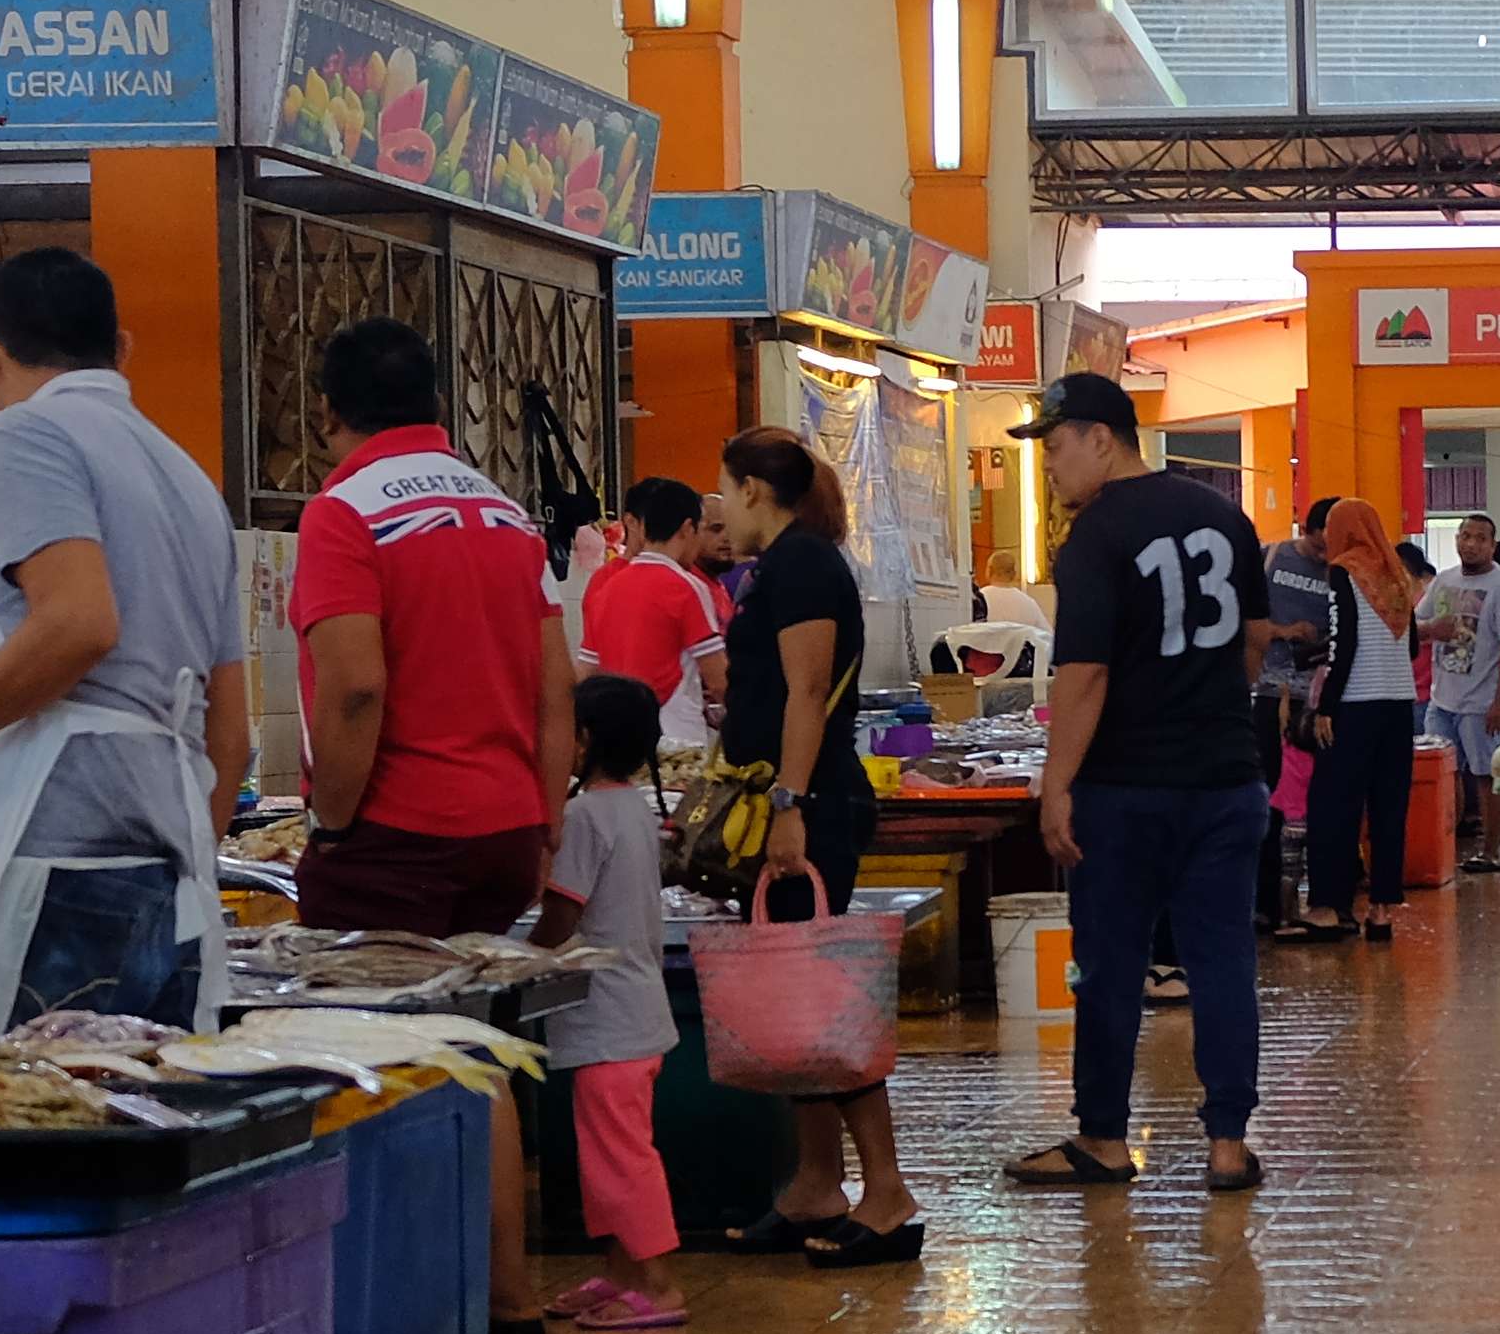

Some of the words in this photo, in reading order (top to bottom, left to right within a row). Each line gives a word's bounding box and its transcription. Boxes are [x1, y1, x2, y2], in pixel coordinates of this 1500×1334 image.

[7, 70, 94, 99] GERAI
[104, 70, 173, 98] IKAN
[617, 232, 741, 261] ALONG
[656, 268, 743, 287] SANGKAR
[382, 474, 449, 499] GREAT
[1134, 527, 1240, 657] 13
